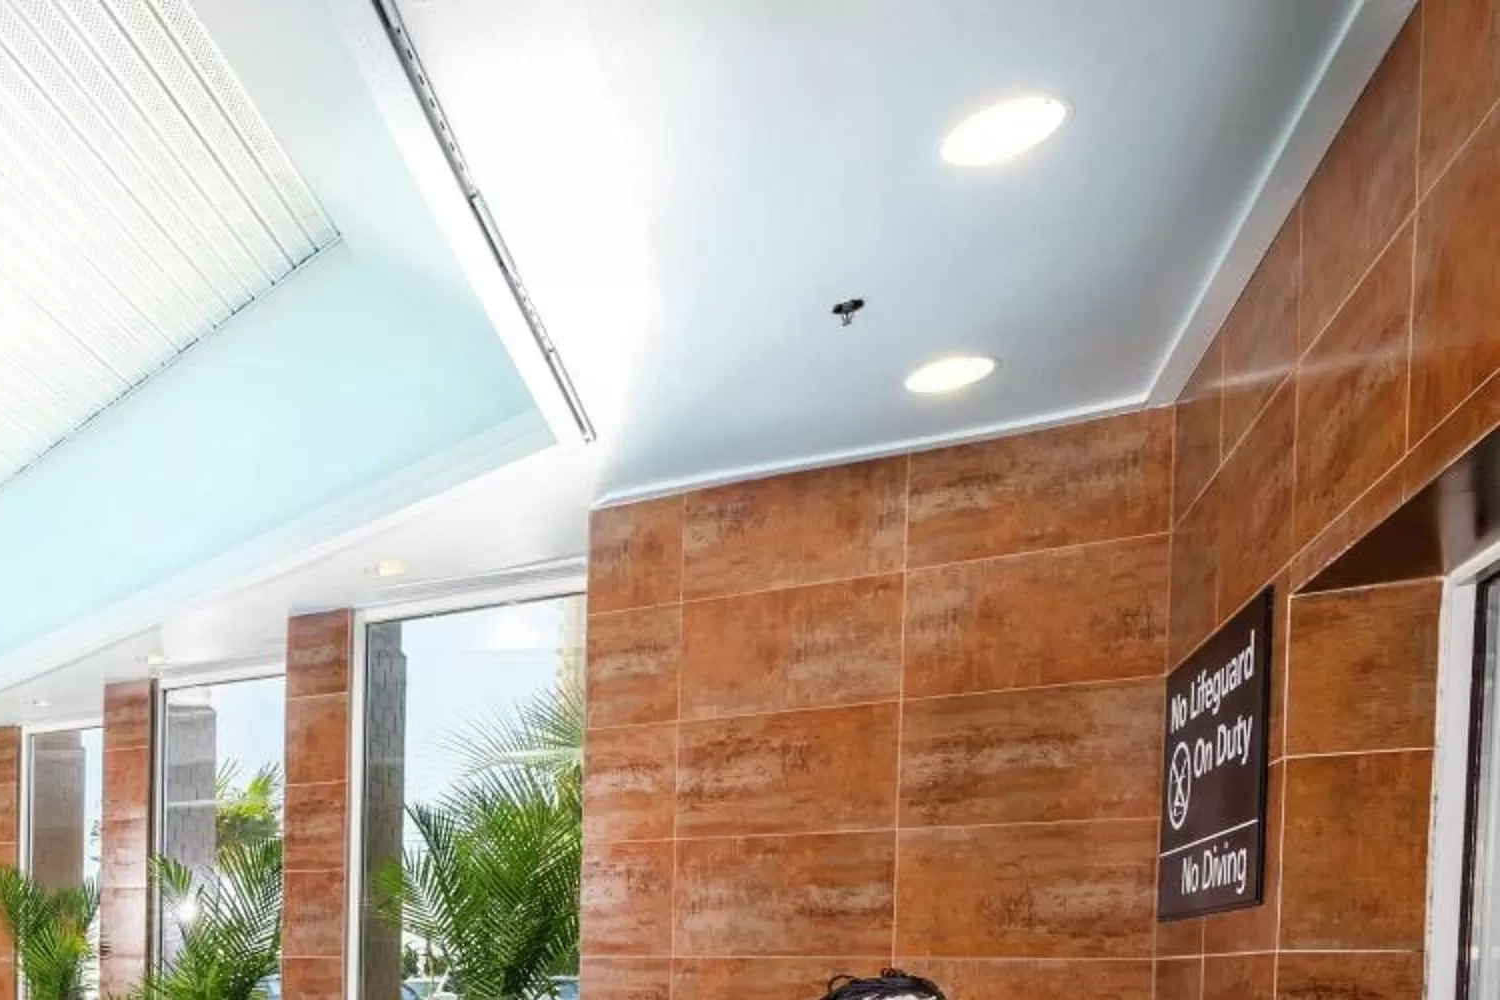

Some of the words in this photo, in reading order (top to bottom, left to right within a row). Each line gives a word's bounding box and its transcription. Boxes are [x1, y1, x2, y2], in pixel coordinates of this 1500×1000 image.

[1171, 692, 1188, 734] No
[1189, 628, 1256, 720] Lifeguard
[1192, 737, 1213, 779] On
[1215, 714, 1253, 766] Duty
[1181, 855, 1199, 896] No
[1201, 841, 1247, 896] Diving
